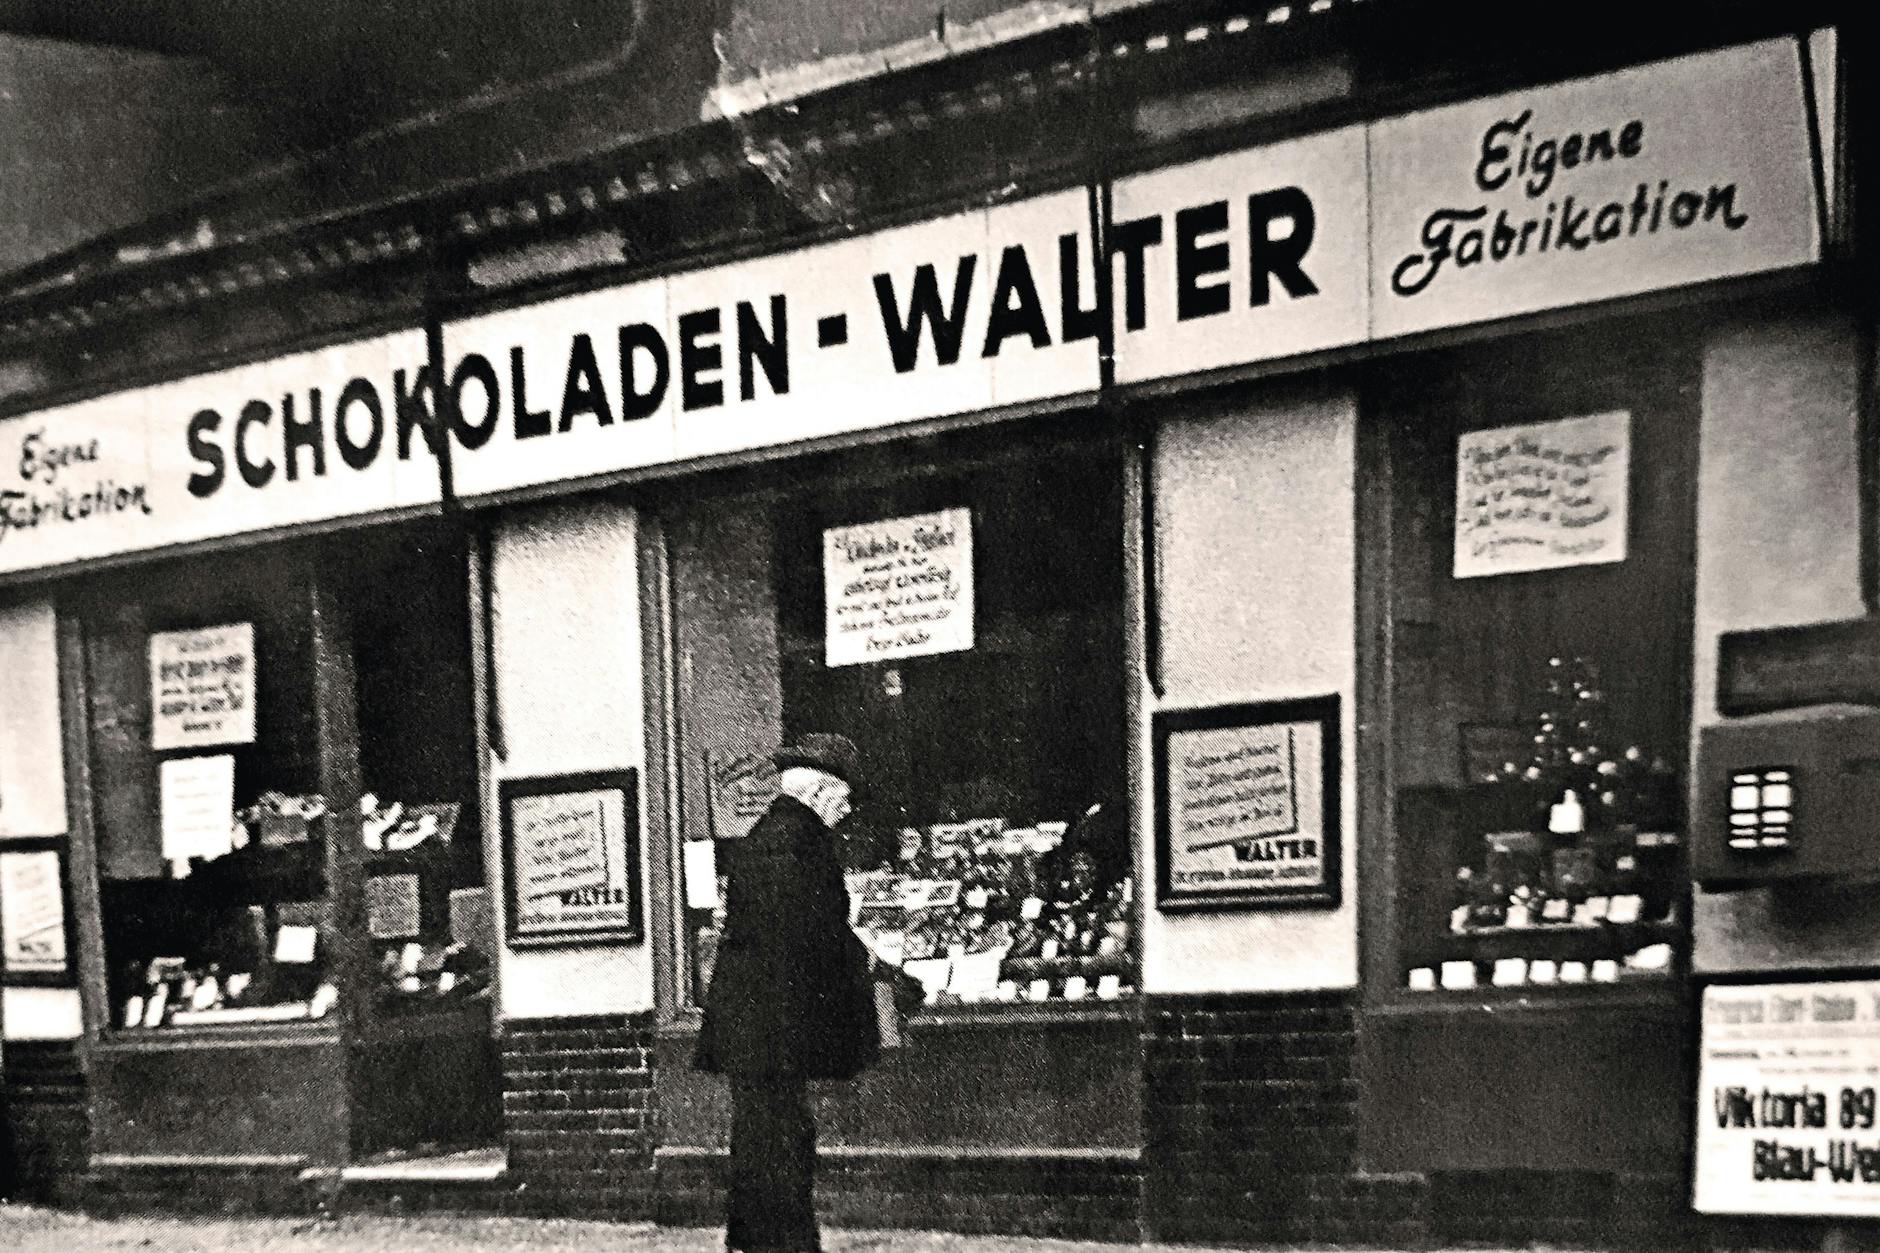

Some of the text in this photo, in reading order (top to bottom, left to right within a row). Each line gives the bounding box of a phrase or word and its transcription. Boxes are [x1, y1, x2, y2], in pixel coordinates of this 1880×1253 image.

[1475, 108, 1643, 198] Eigene
[1391, 179, 1749, 297] Fabrikation
[187, 293, 790, 498] SCHOKOLADEN
[872, 185, 1320, 374] WALTER
[1232, 838, 1318, 863] WALTER
[1714, 1085, 1876, 1129] Viktoria 89
[1752, 1137, 1880, 1184] Blau-We
